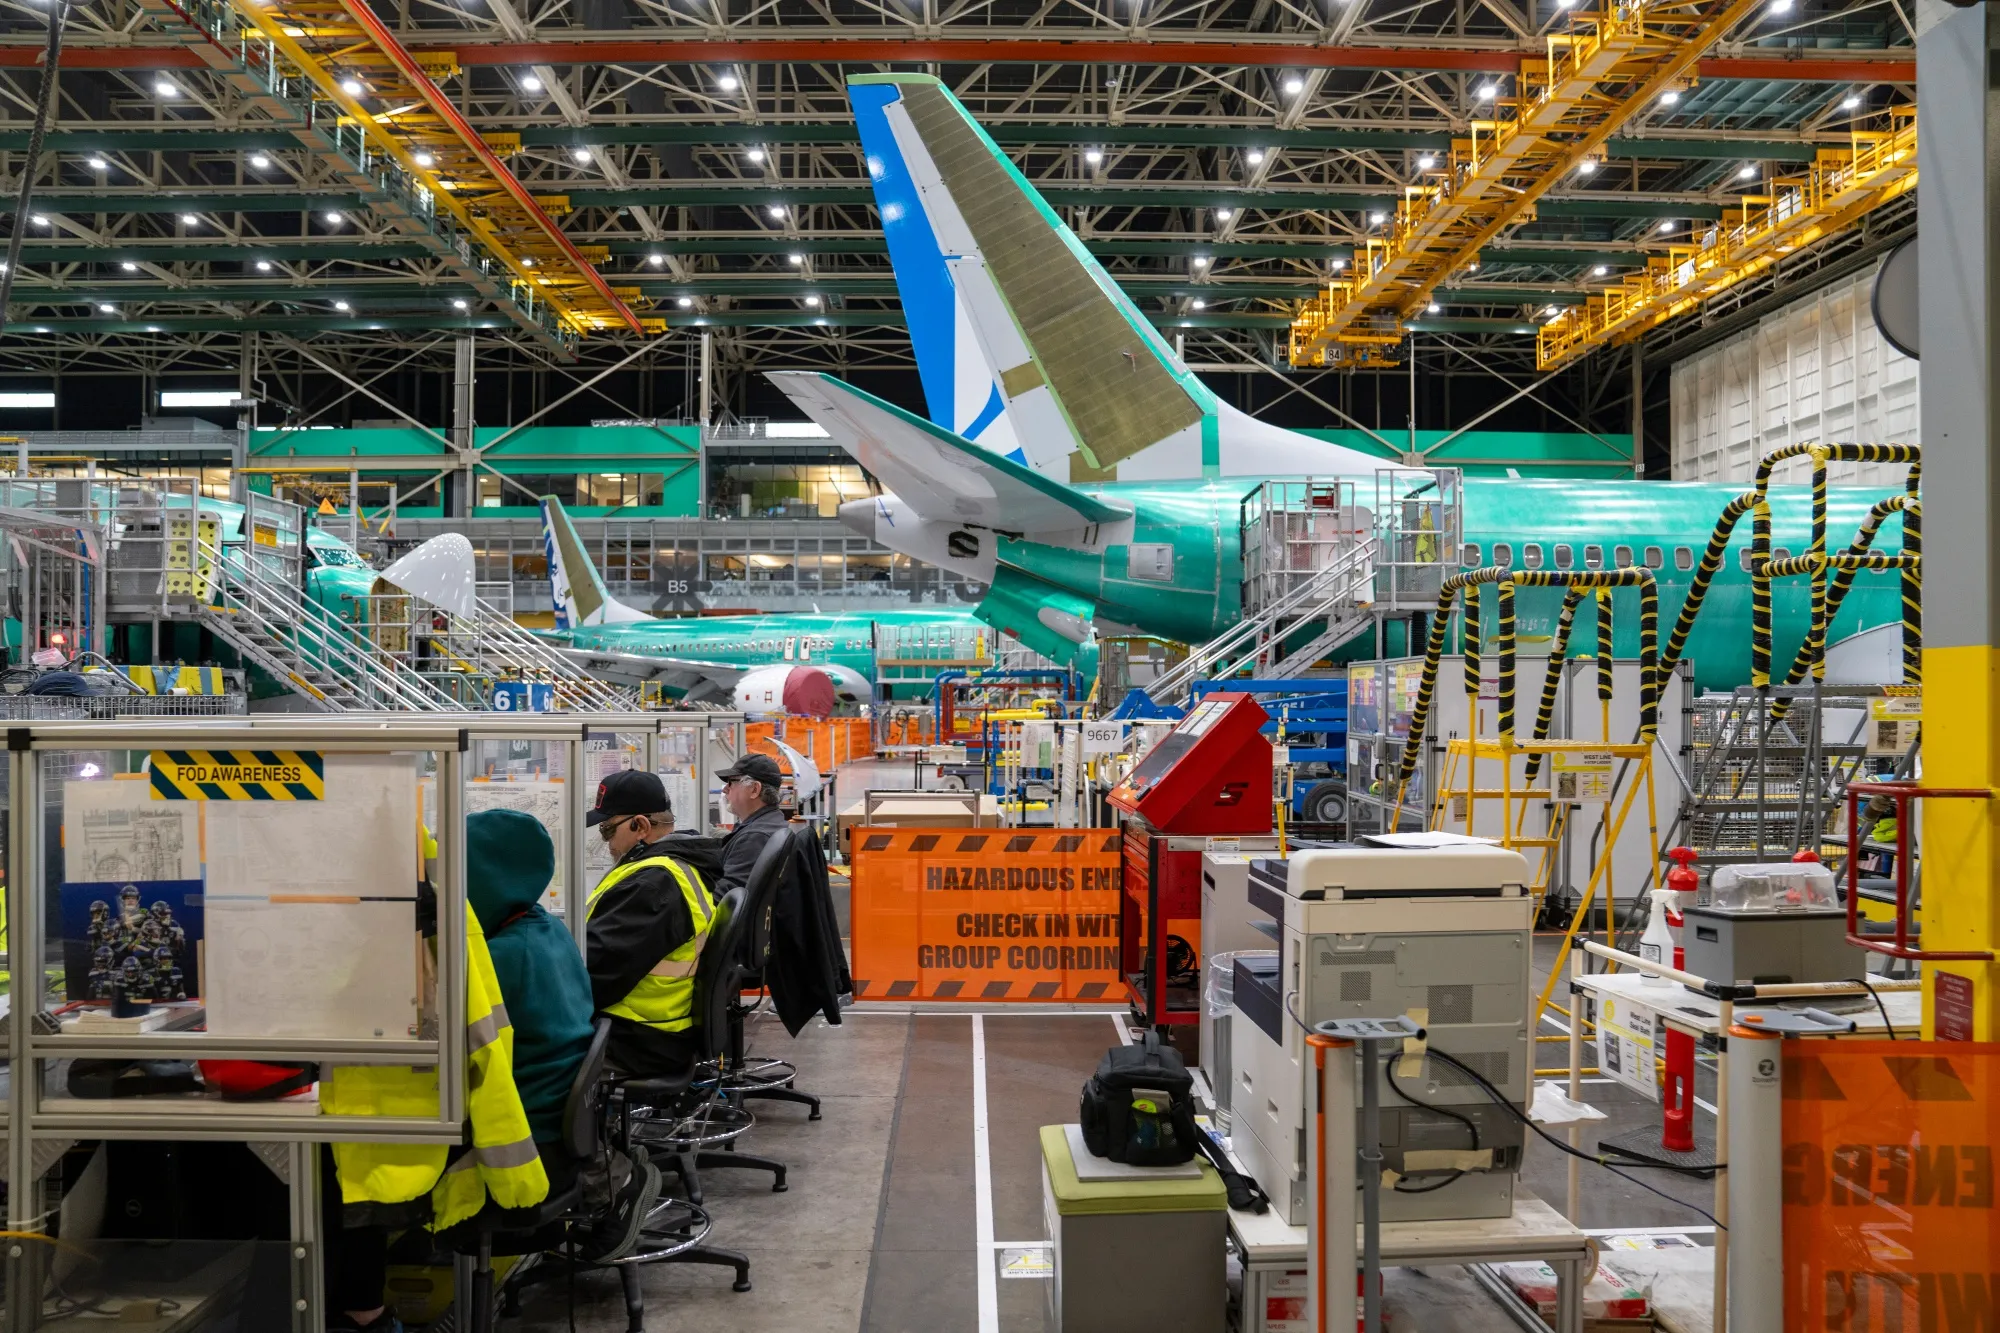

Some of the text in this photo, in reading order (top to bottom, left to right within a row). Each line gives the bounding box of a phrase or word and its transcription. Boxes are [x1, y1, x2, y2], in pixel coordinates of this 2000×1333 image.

[1328, 349, 1340, 360] 84
[668, 580, 688, 594] B5
[494, 690, 511, 711] 6
[1087, 730, 1118, 741] 9667
[177, 766, 301, 782] FOD AWARENESS
[927, 867, 1075, 891] HAZARDOUS
[957, 913, 1039, 937] CHECK
[1045, 914, 1070, 937] IN
[918, 945, 1001, 969] GROUP
